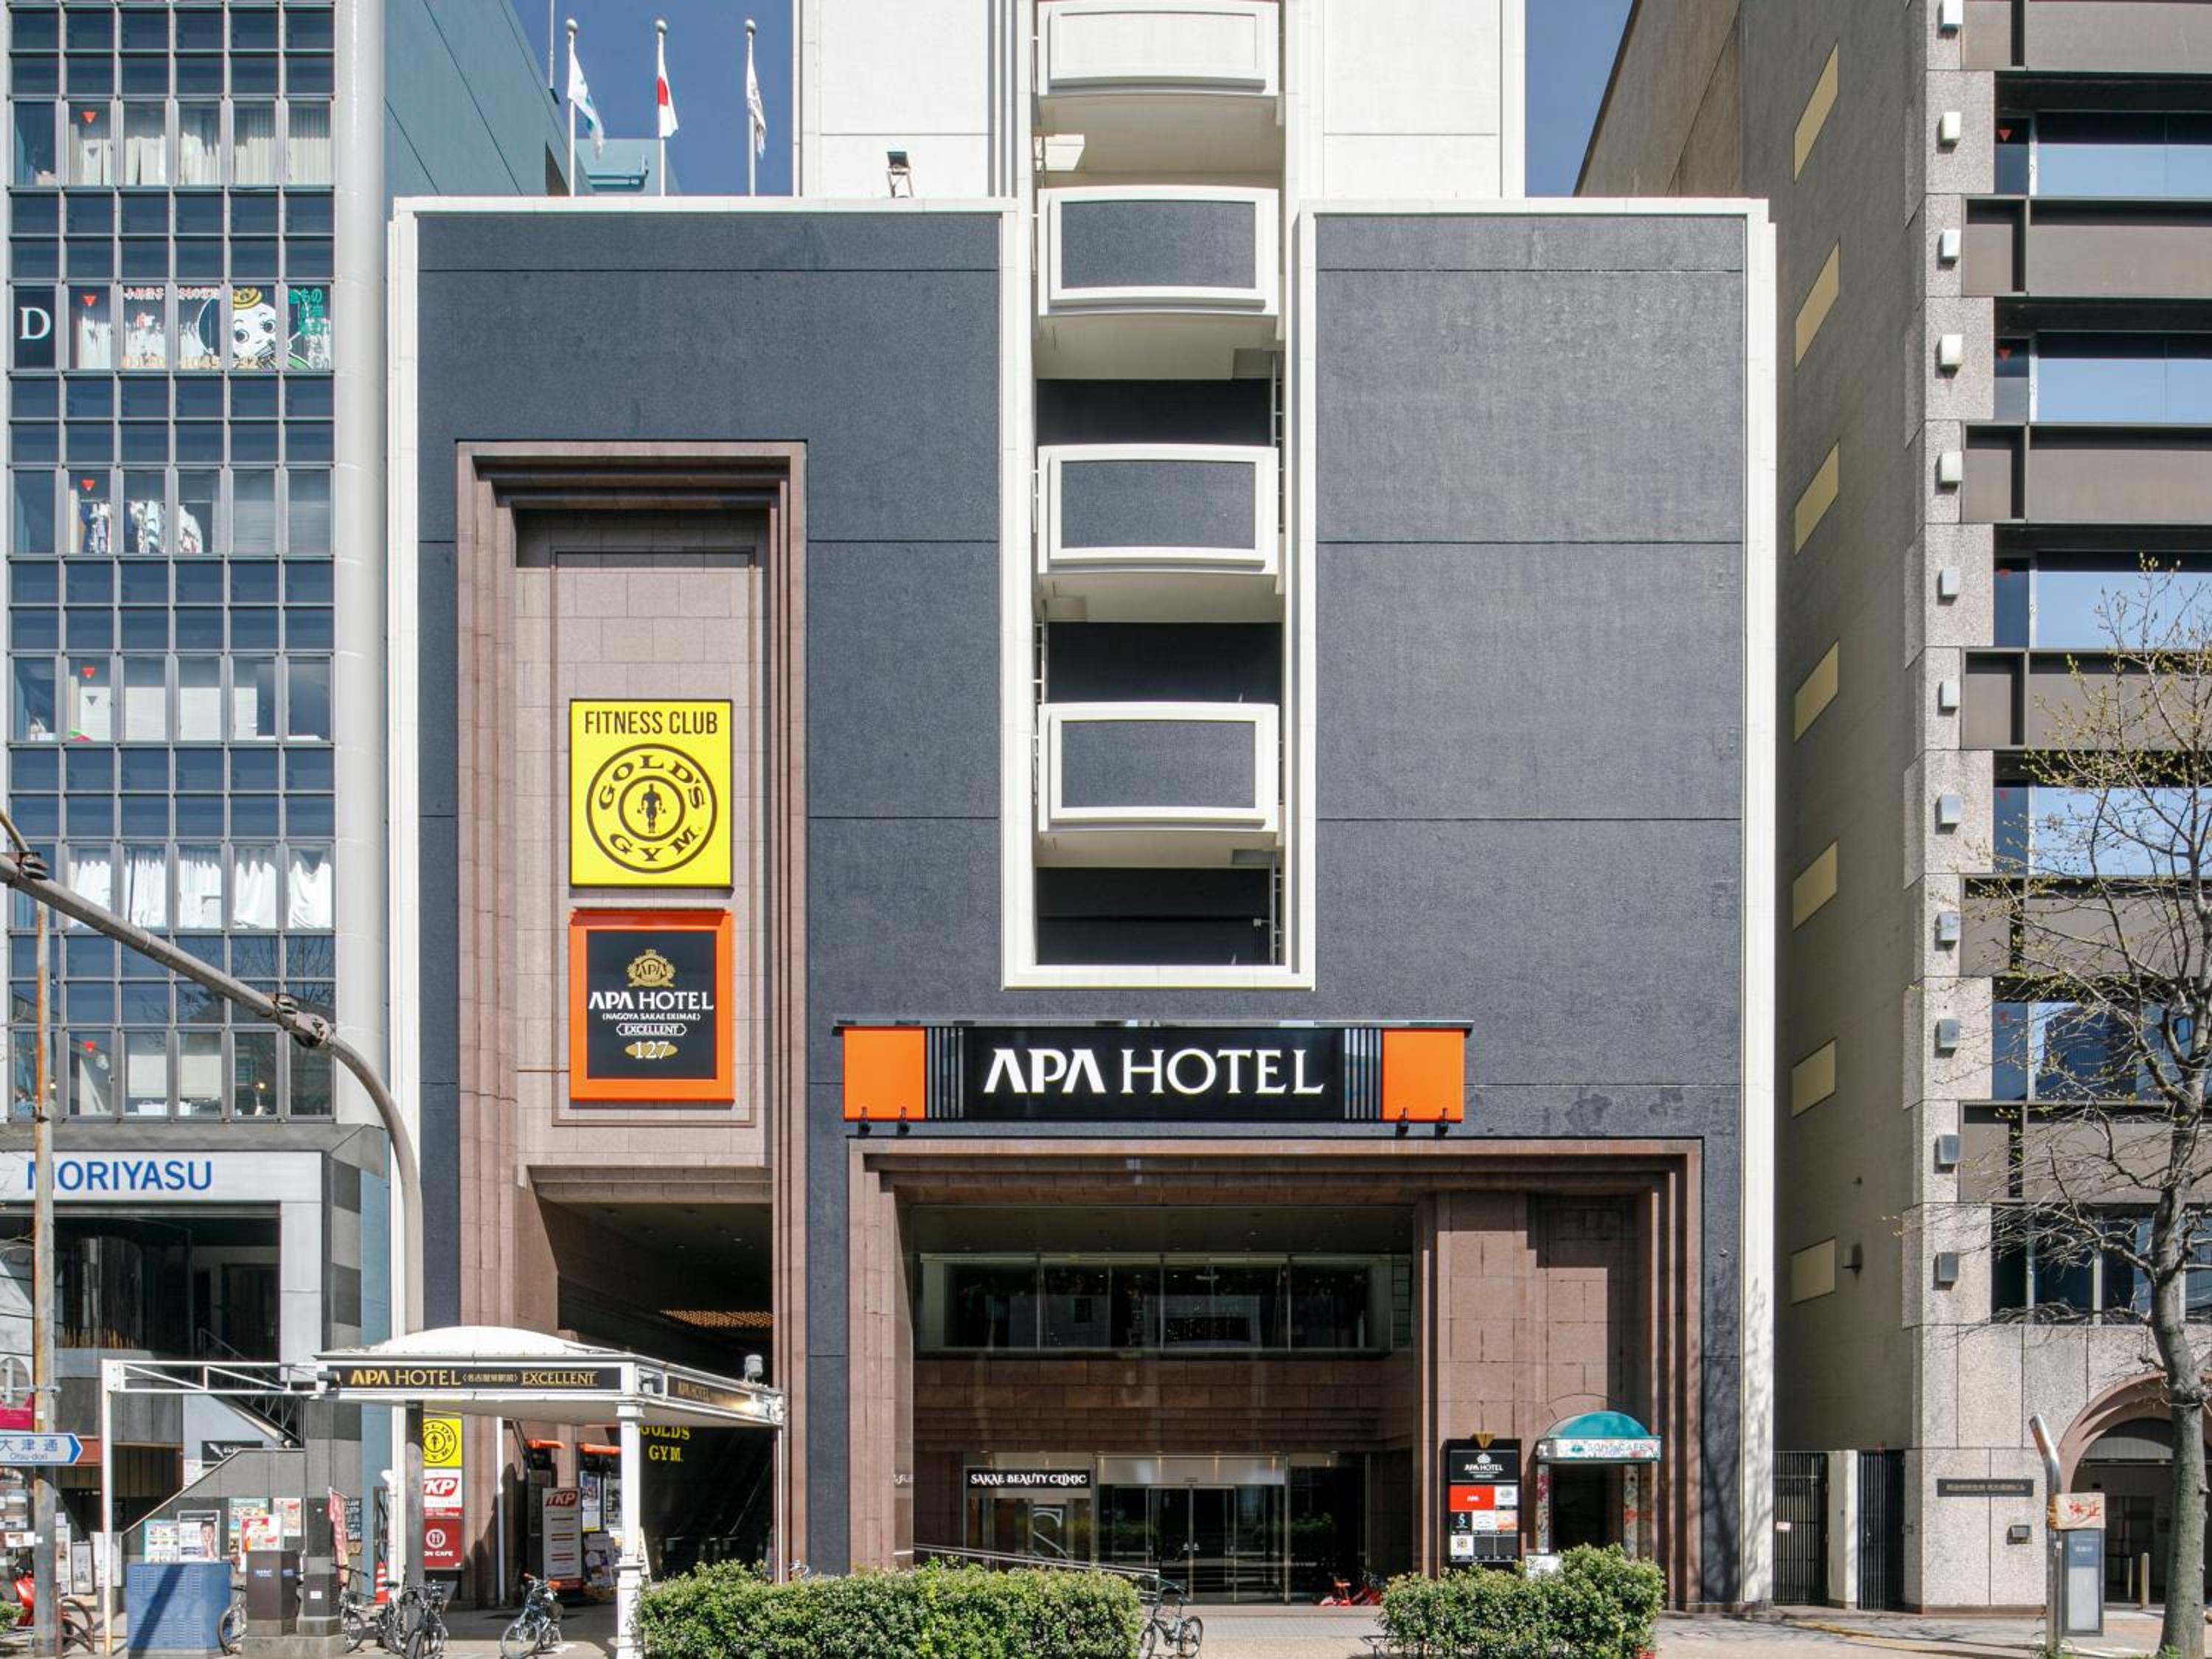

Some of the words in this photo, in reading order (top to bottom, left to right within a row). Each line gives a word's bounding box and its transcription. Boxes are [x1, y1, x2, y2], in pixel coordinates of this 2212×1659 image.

[18, 307, 51, 339] D
[585, 711, 662, 734] FITNESS
[669, 711, 717, 734] CLUB
[599, 755, 705, 810] GOLD'S
[610, 827, 700, 862] GYM
[588, 992, 634, 1009] APA
[639, 992, 714, 1010] HOTEL
[625, 1026, 678, 1034] EXCELLENT
[634, 1041, 669, 1059] 127
[984, 1048, 1105, 1093] APA
[1121, 1048, 1324, 1095] HOTEL
[350, 1369, 390, 1385] APA
[394, 1369, 461, 1385] HOTEL
[522, 1371, 597, 1385] EXCELLENT
[0, 1439, 58, 1451] 大津通
[649, 1444, 681, 1462] GYM
[425, 1478, 456, 1496] KP
[970, 1474, 1004, 1486] SAKAE
[1006, 1472, 1048, 1486] BEAUTY
[1049, 1473, 1087, 1486] CLINIC
